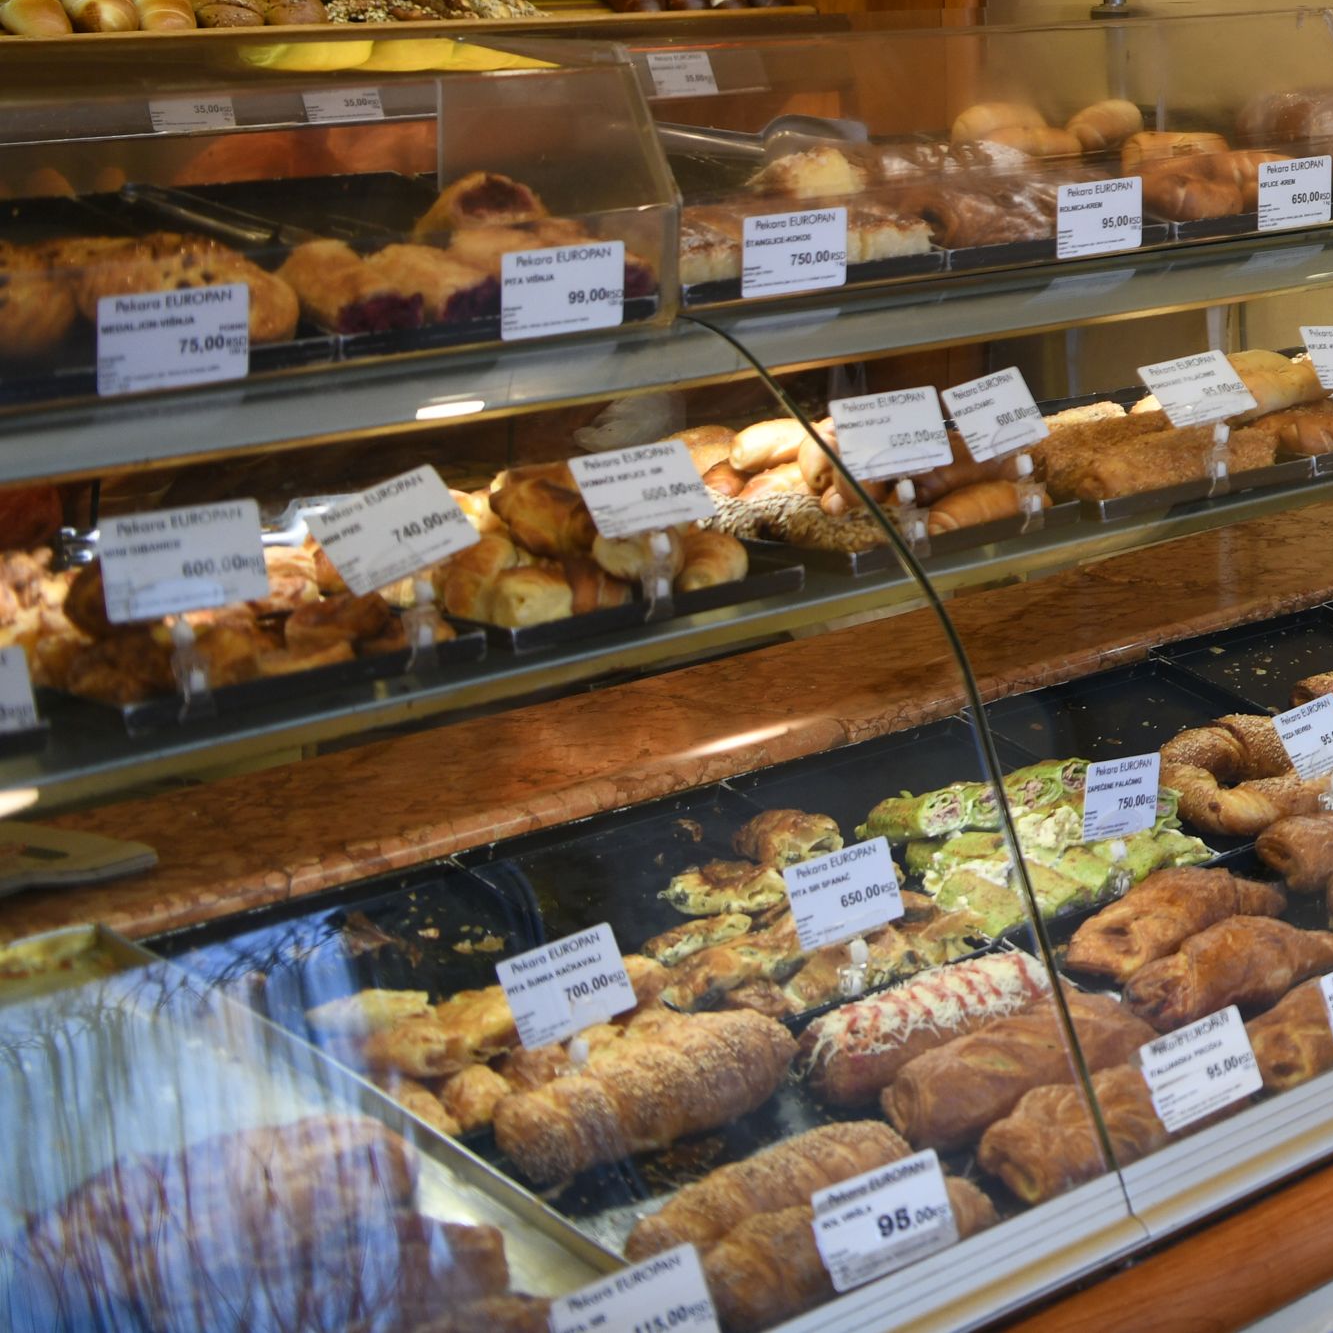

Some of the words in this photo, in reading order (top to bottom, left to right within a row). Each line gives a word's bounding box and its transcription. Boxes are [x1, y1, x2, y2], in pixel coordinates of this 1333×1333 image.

[1291, 159, 1324, 172] EUROPAN
[1095, 181, 1133, 195] EUROPAN
[789, 212, 836, 227] EUROPAN
[556, 247, 612, 263] EUROPAN
[504, 277, 523, 286] PITA
[165, 289, 232, 308] EUROPAN
[1120, 758, 1153, 772] EUROPAN
[796, 862, 829, 880] Pekara
[829, 844, 877, 868] EUROPAN
[510, 954, 547, 975] Pekara
[547, 931, 601, 961] EUROPAN
[868, 1160, 926, 1192] EUROPAN
